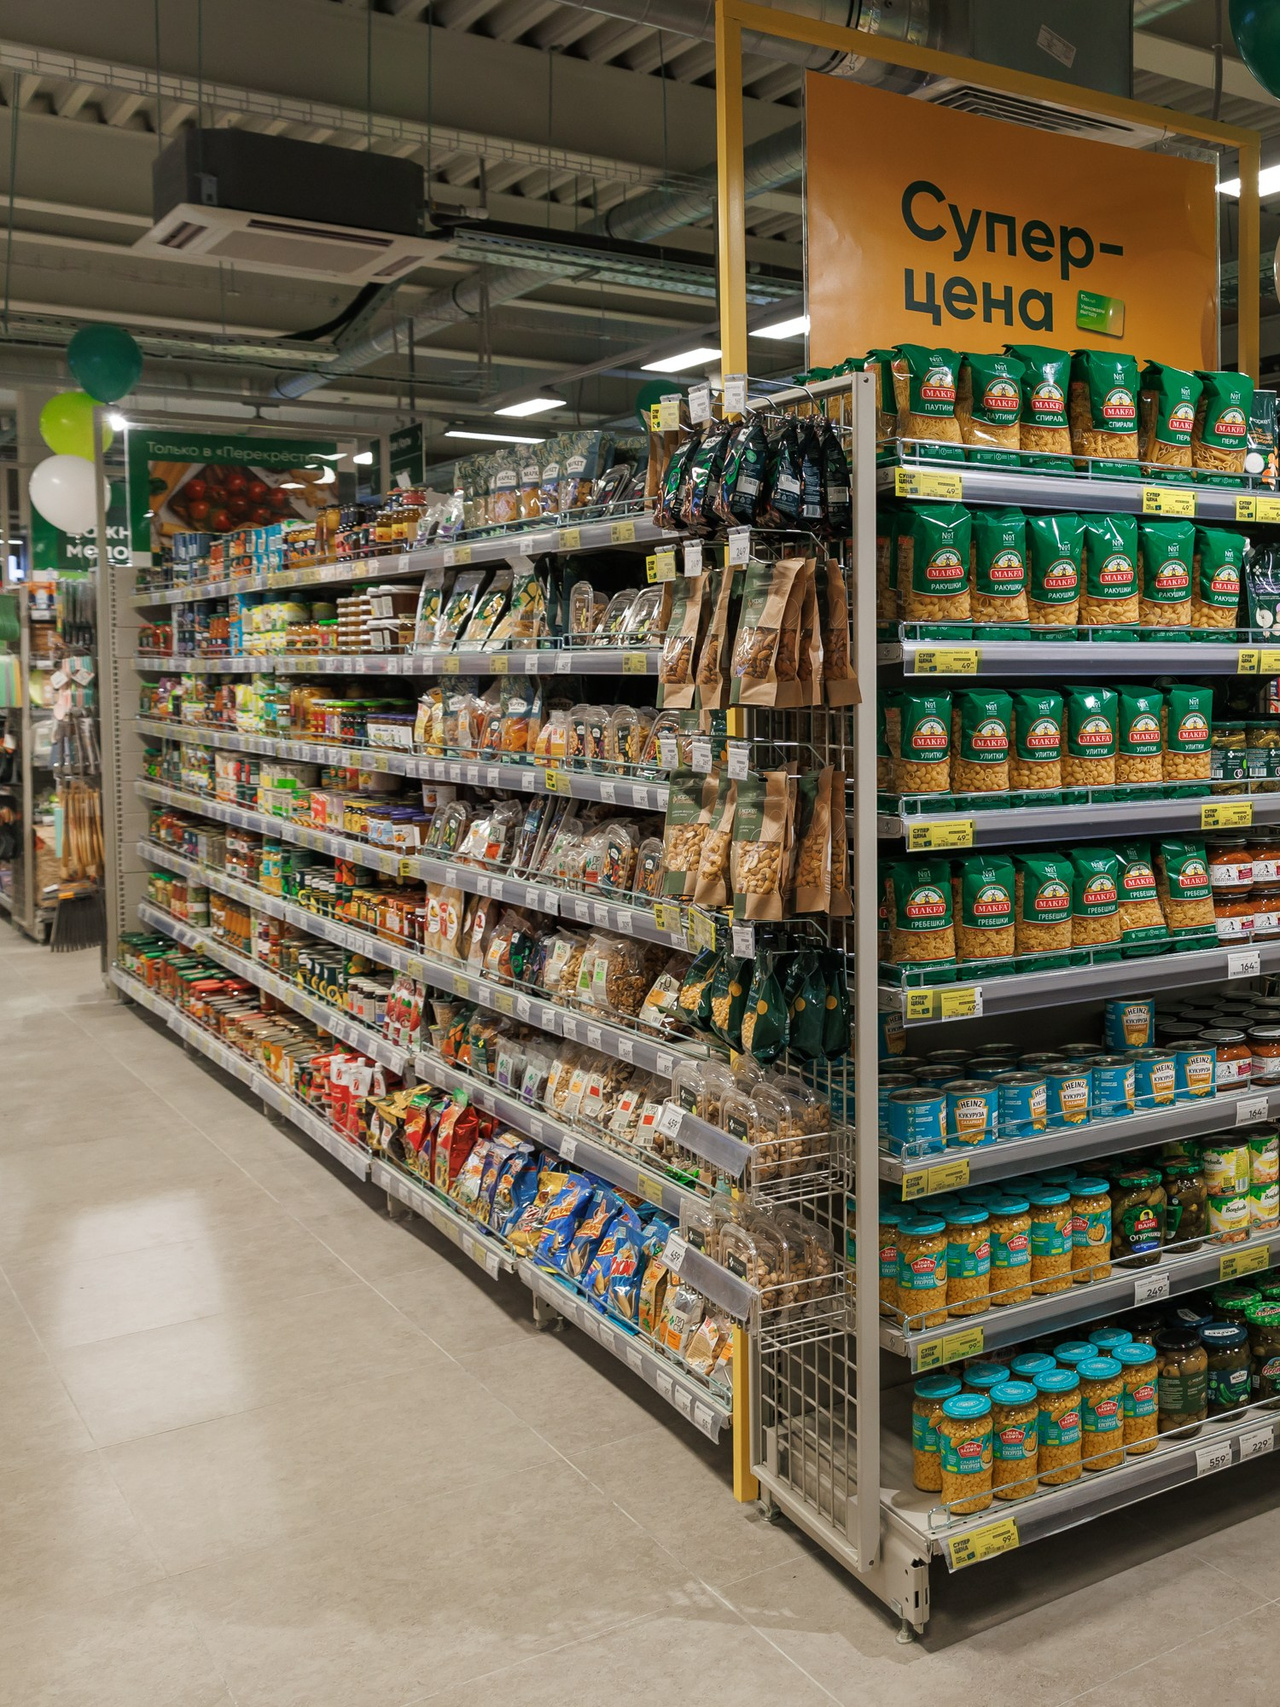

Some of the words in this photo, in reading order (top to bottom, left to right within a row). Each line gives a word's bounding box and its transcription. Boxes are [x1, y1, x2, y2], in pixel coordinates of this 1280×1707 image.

[901, 180, 1124, 281] Супер-
[904, 268, 1054, 332] цена
[1107, 408, 1133, 416] MAKFA
[1218, 425, 1245, 434] MAKFA
[147, 441, 199, 456] Только
[993, 570, 1022, 578] MAKFA
[1104, 573, 1133, 581] MAKFA
[1048, 577, 1075, 586] MAKFA
[916, 738, 946, 747] MAKFA
[976, 739, 1007, 747] MAKFA
[1031, 737, 1060, 746] MAKFA
[1083, 735, 1111, 744] MAKFA
[1126, 877, 1155, 887] MAKFA
[1183, 877, 1208, 886] MAKFA
[1086, 892, 1116, 902] MAKFA
[977, 903, 1009, 913] MAKFA
[1038, 899, 1069, 908] MAKFA
[910, 906, 944, 915] MAKFA
[1190, 1056, 1210, 1064] HEINZ
[1156, 1064, 1173, 1073] HEINZ
[1065, 1082, 1085, 1090] HEINZ
[960, 1100, 983, 1109] HEINZ
[1252, 1440, 1268, 1451] 229
[1209, 1455, 1226, 1467] 559
